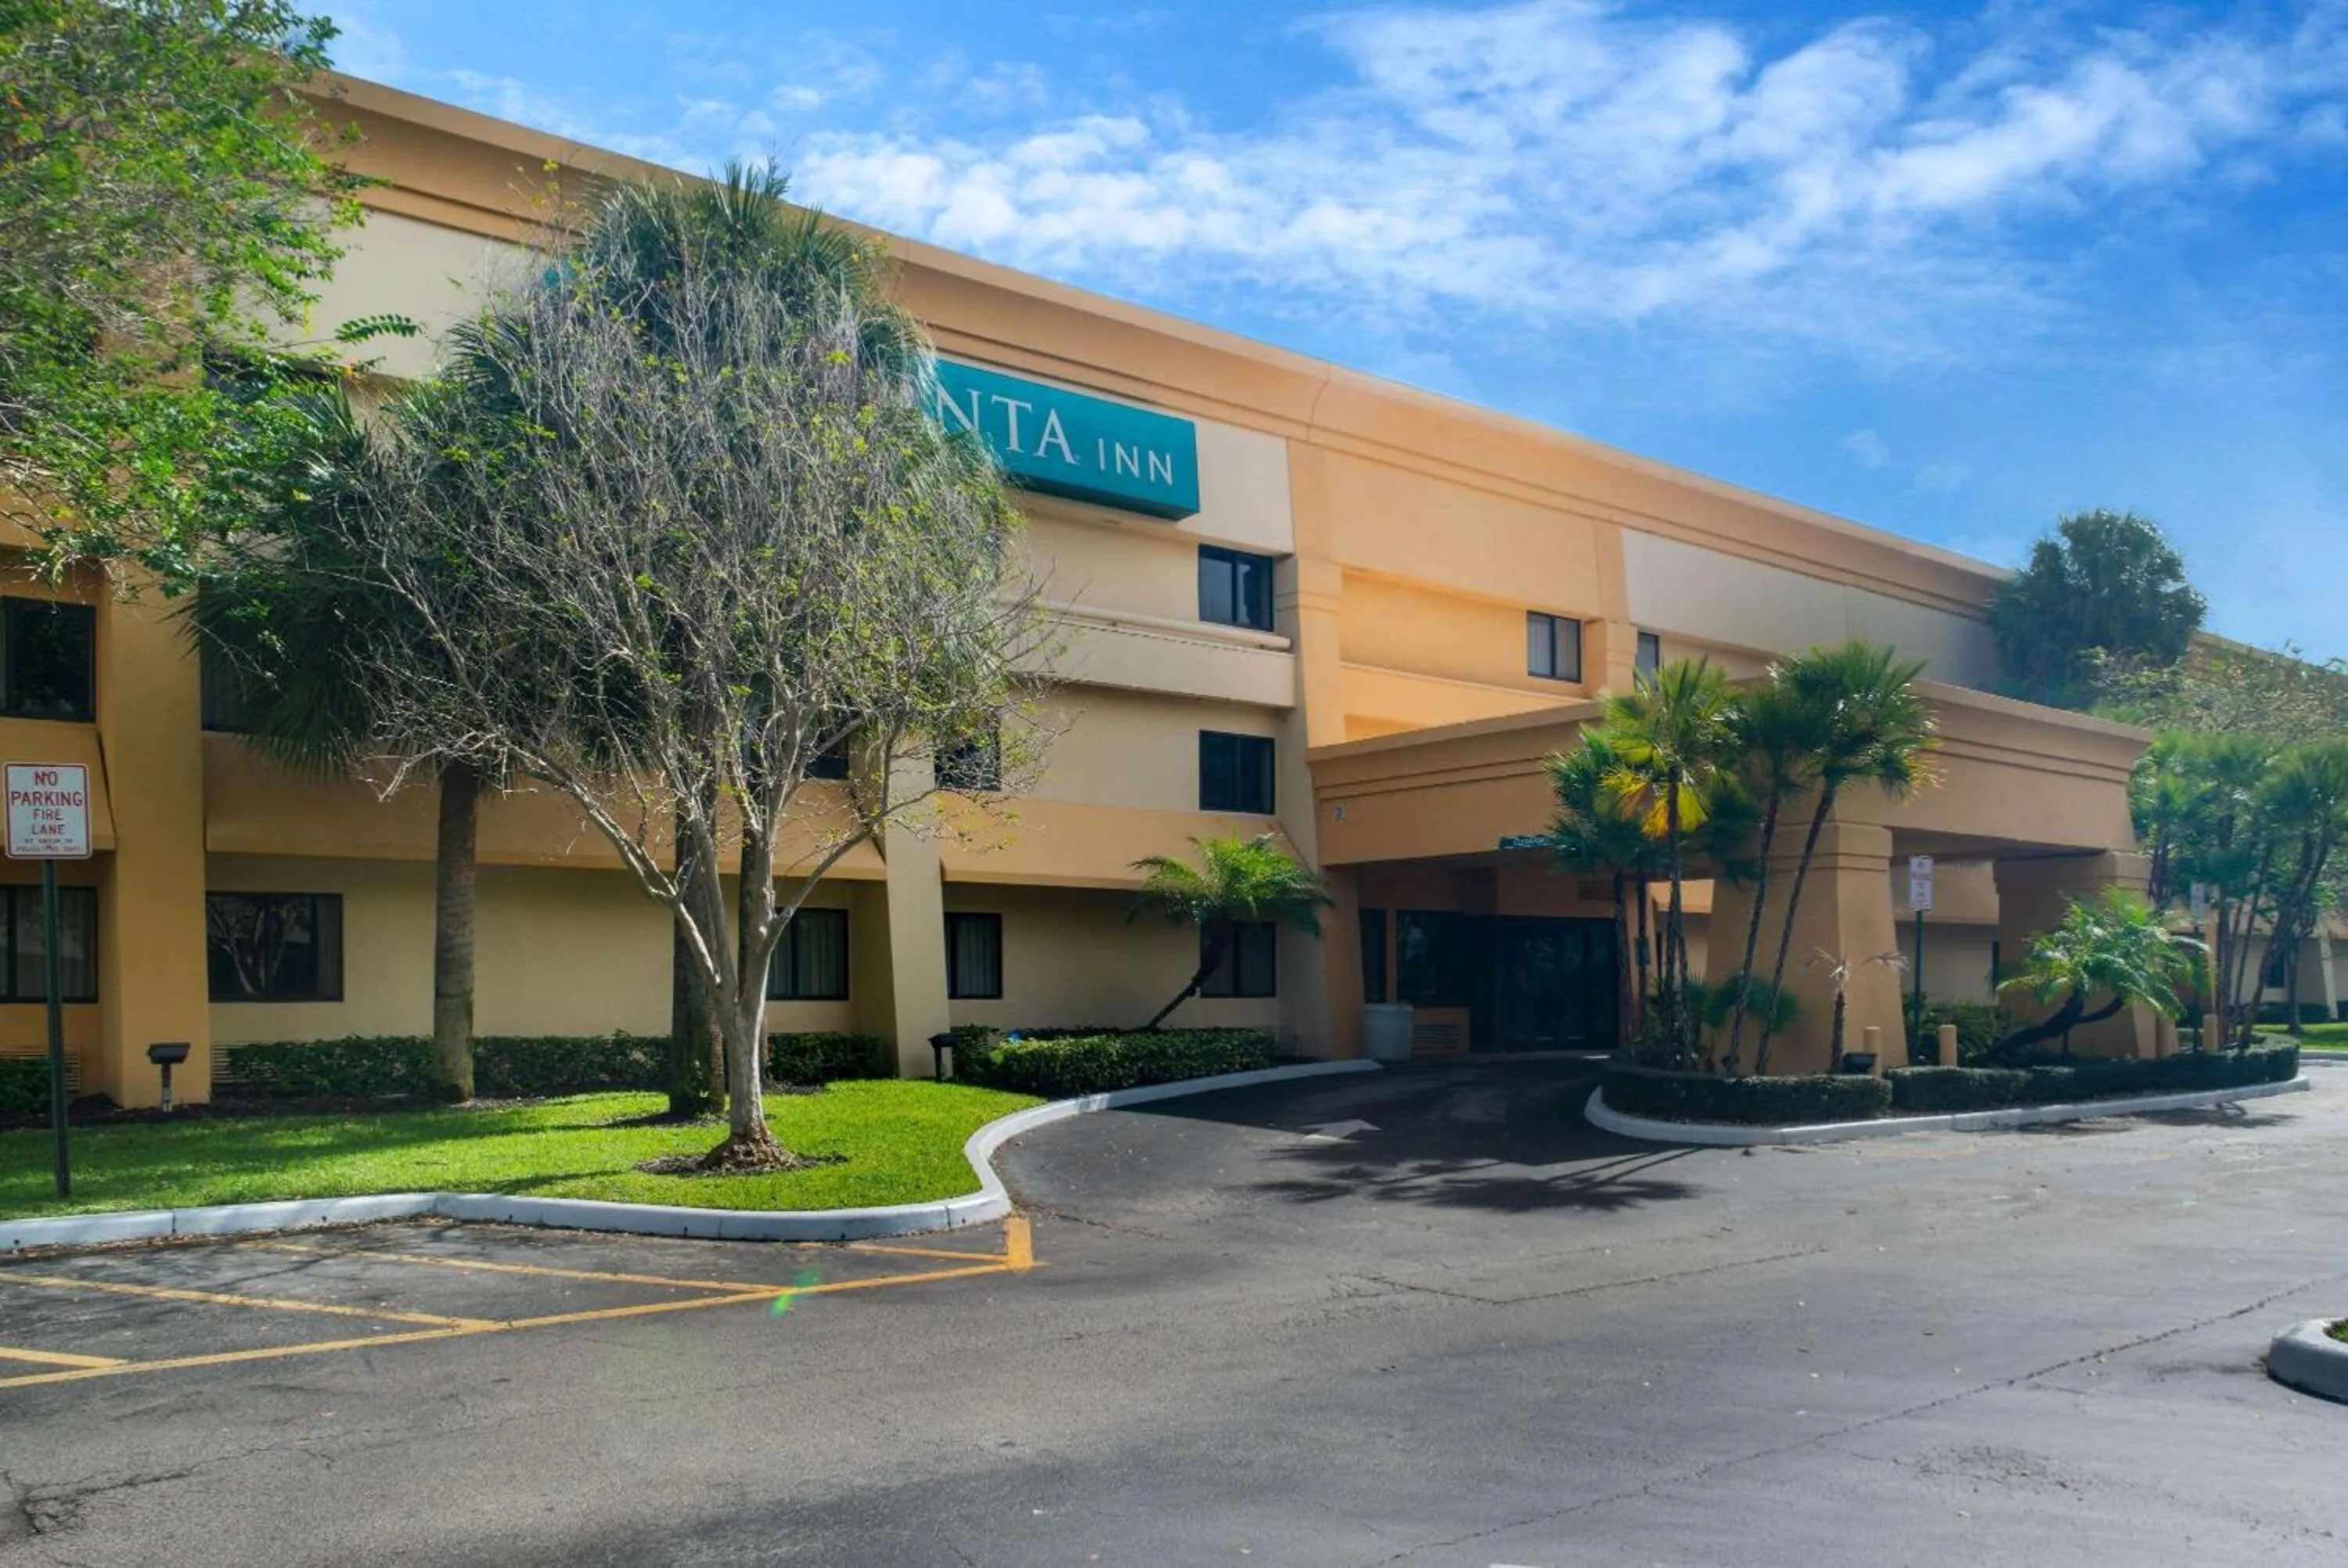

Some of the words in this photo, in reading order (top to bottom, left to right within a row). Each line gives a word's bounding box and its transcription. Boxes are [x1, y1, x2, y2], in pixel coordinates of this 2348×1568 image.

[1098, 437, 1173, 486] INN
[34, 771, 58, 786] NO
[11, 791, 83, 807] PARKING
[34, 808, 63, 821] FIRE
[31, 824, 65, 835] LANE
